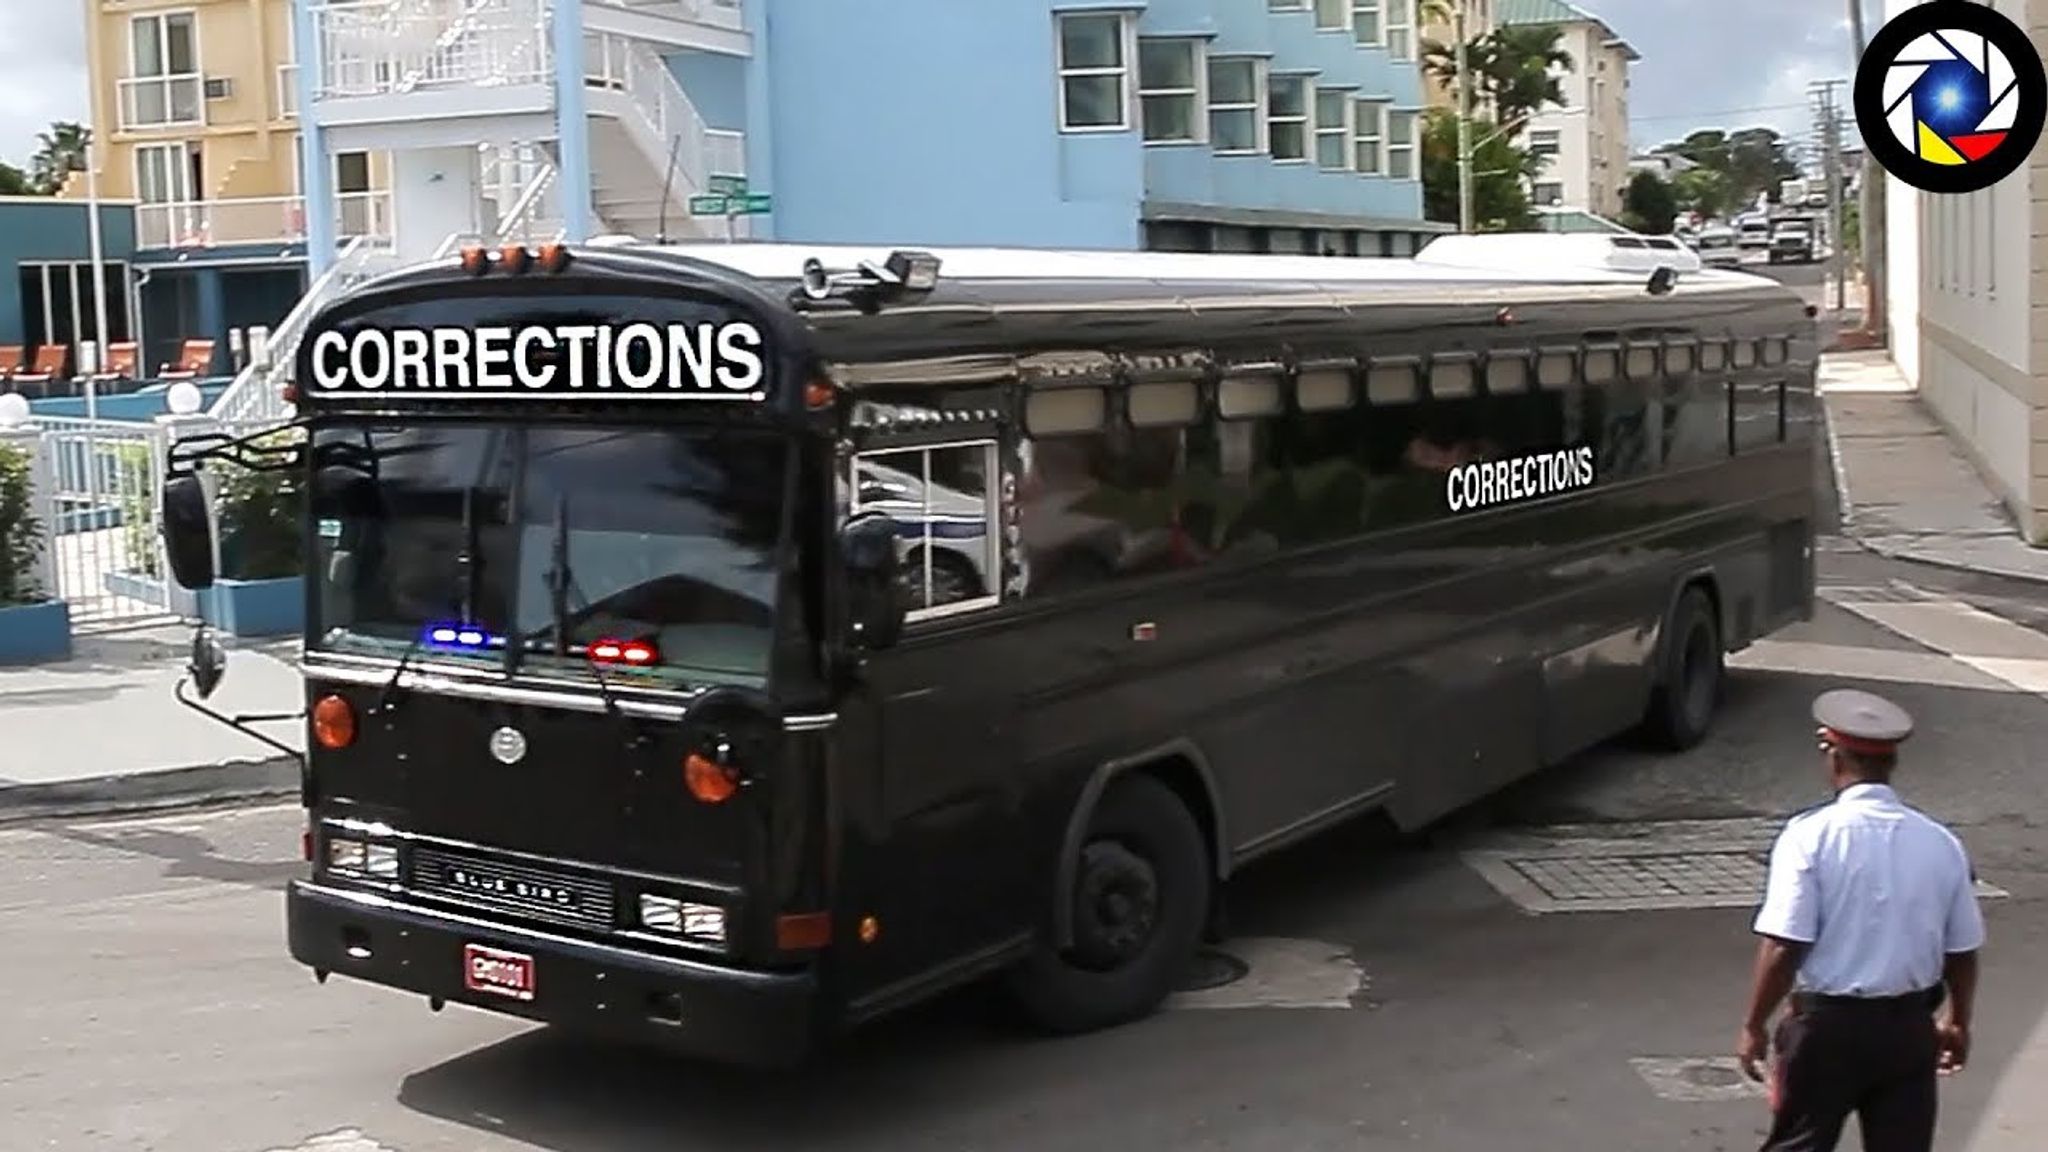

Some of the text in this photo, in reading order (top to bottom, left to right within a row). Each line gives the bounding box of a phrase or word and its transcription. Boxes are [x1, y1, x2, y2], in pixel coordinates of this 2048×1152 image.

[312, 322, 763, 390] CORRECTIONS
[1447, 446, 1594, 512] CORRECTIONS
[455, 871, 508, 892] BLUE
